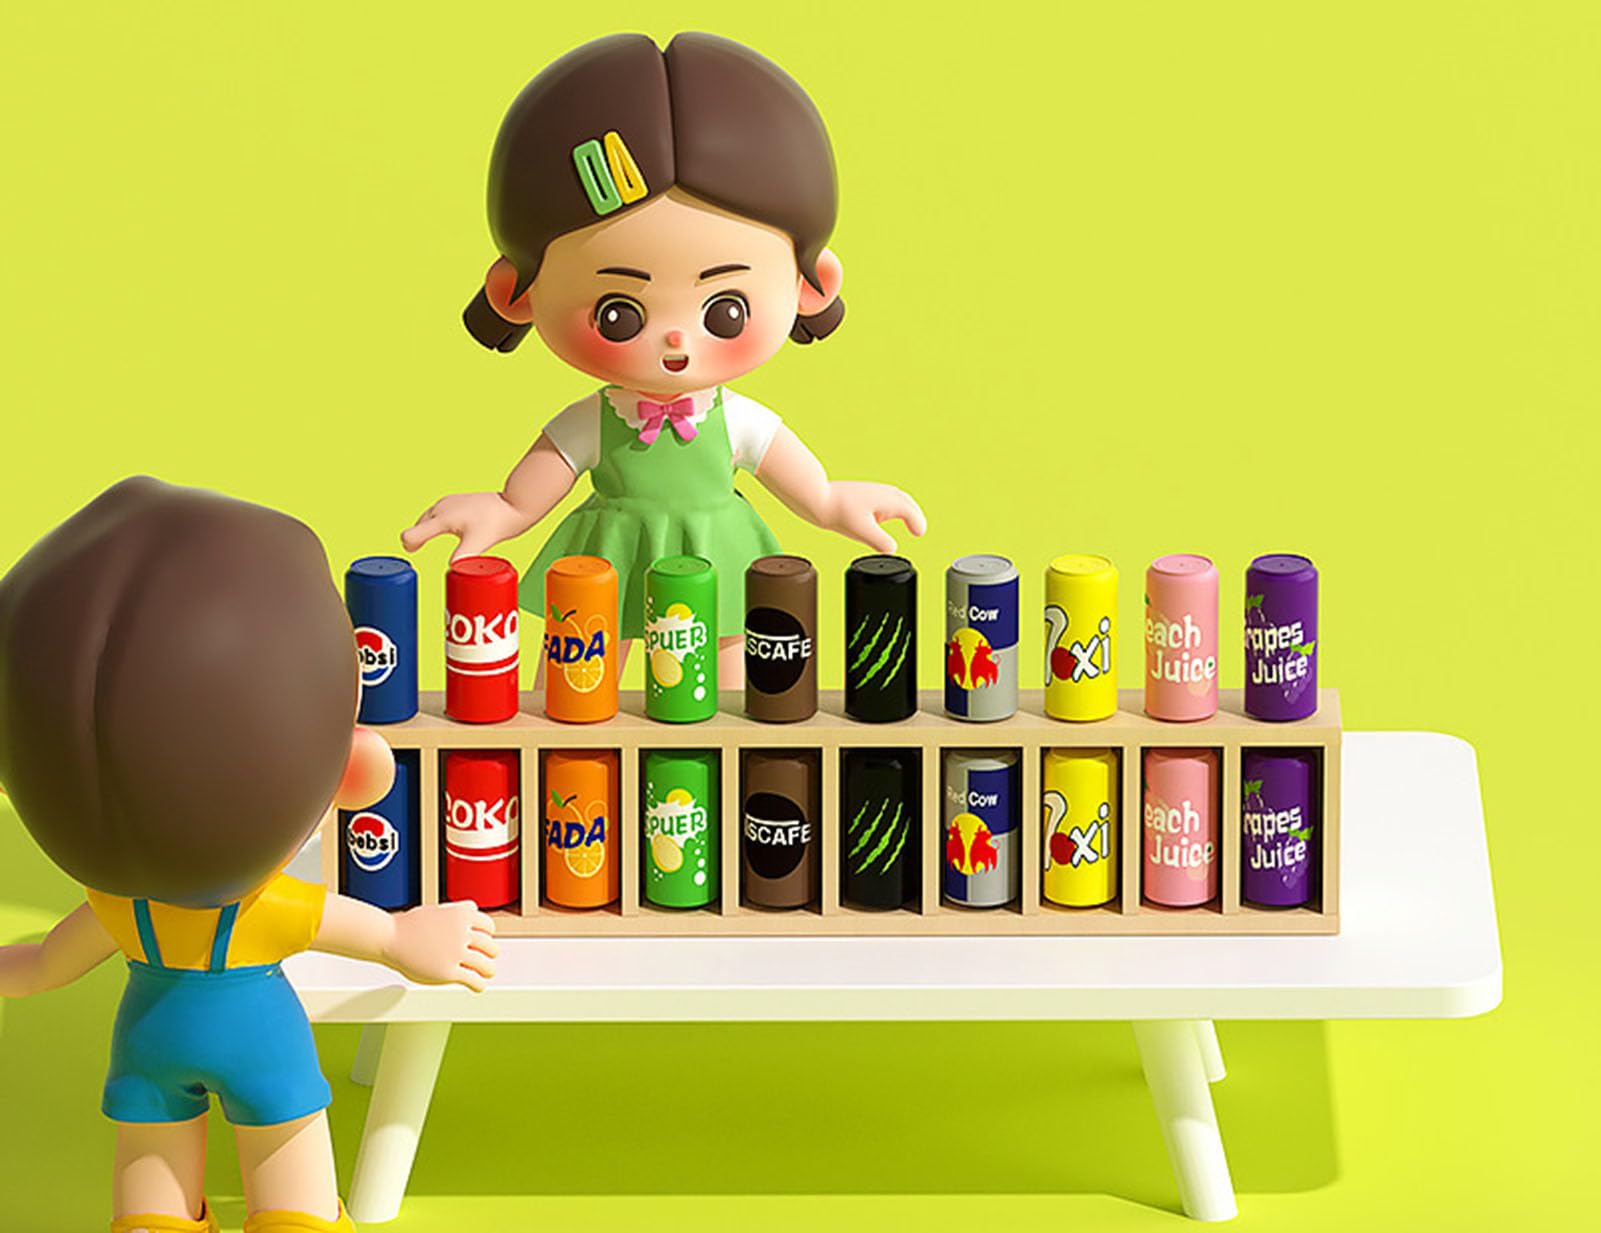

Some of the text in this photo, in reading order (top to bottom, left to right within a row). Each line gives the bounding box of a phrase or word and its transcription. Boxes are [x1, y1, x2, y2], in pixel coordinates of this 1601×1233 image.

[969, 605, 999, 621] Cow
[1151, 650, 1216, 683] Juice
[1252, 655, 1308, 684] Juice
[968, 791, 998, 807] Cow
[1150, 834, 1215, 868] Juice
[1250, 840, 1307, 869] Juice
